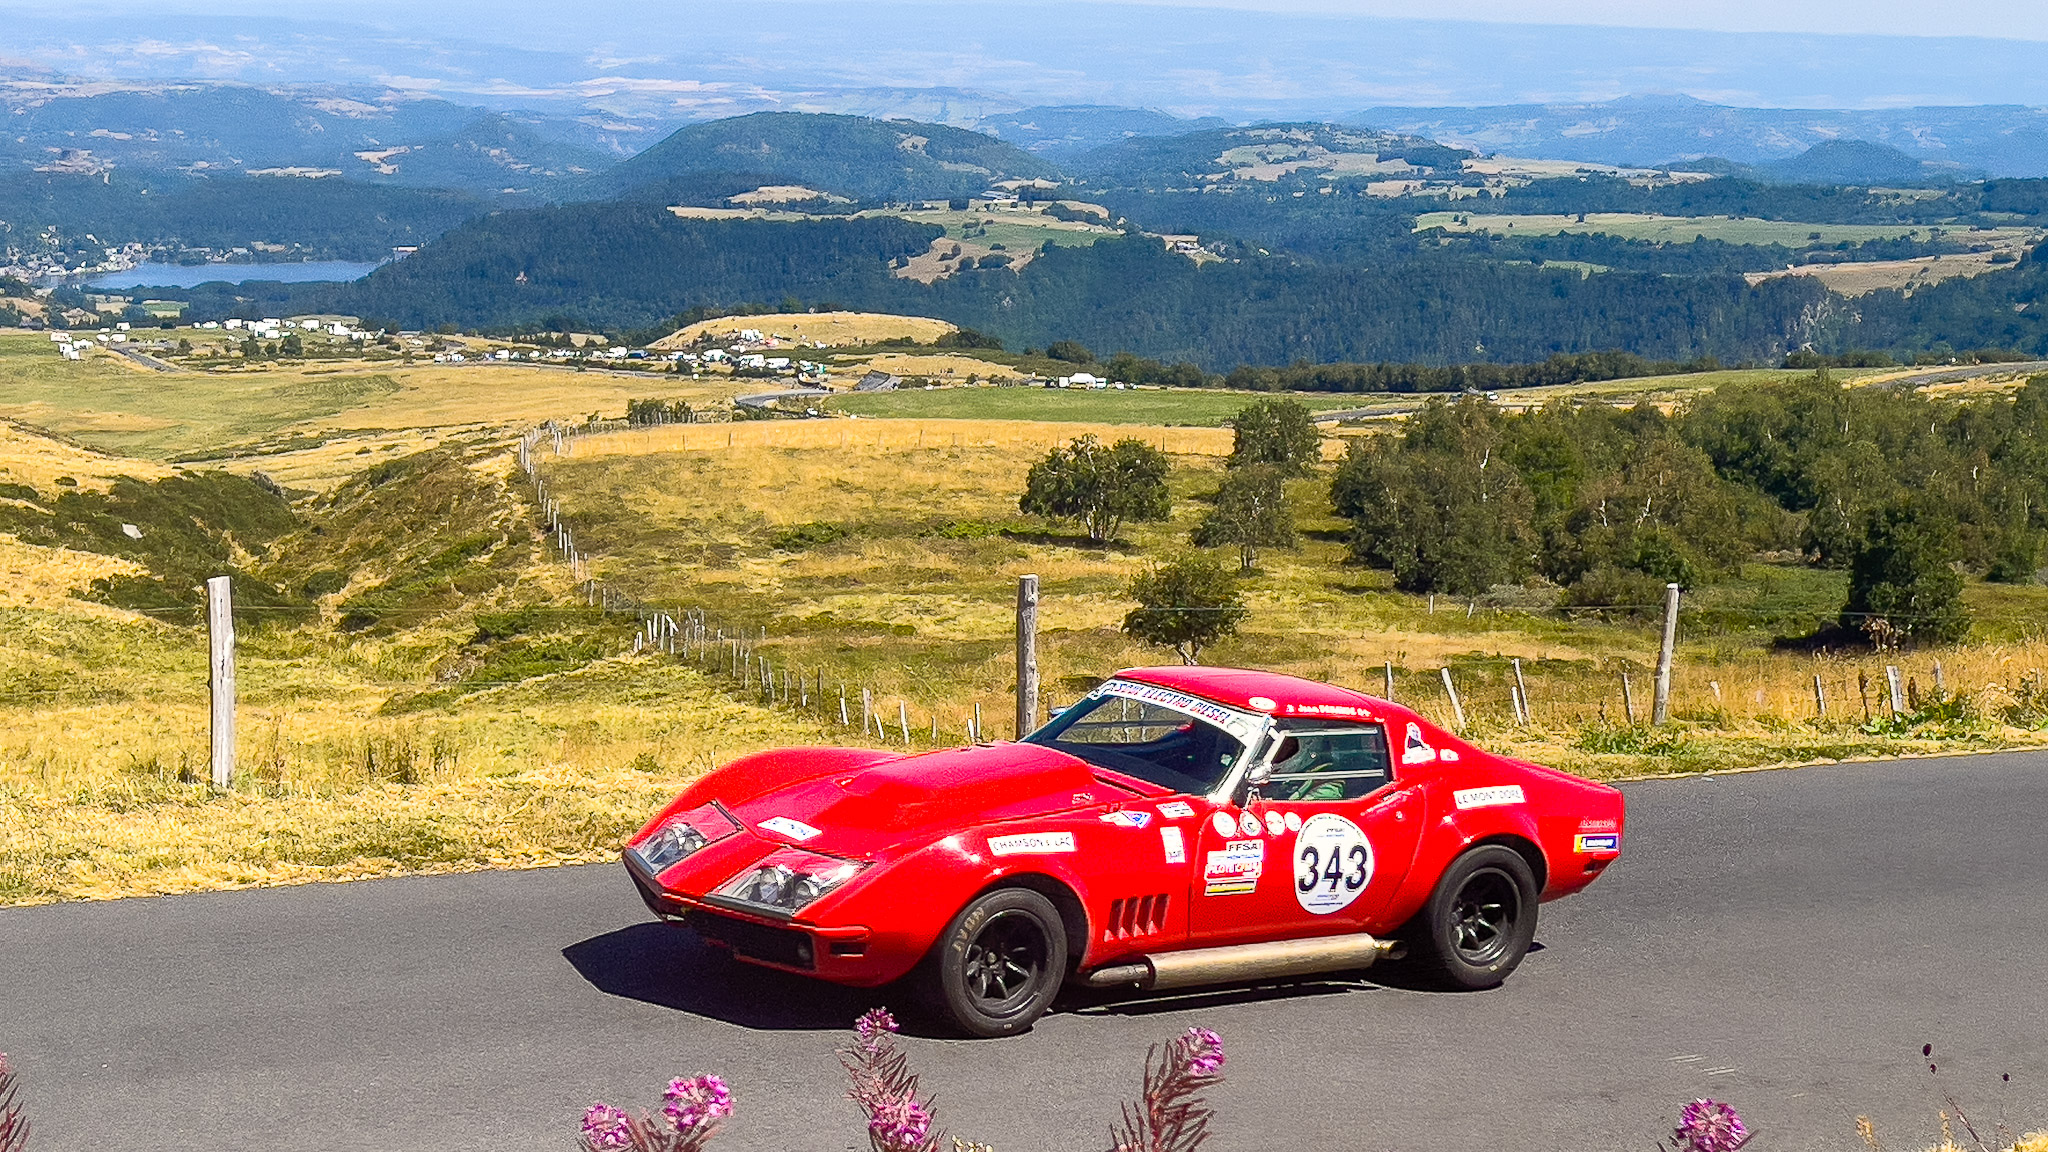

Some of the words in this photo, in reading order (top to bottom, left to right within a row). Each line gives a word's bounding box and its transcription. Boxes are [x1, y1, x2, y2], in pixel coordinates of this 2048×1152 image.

[1142, 688, 1194, 709] ELECTRO
[1190, 702, 1232, 725] DIESEL
[1458, 793, 1469, 805] LE
[1228, 842, 1259, 852] FFSA
[1298, 844, 1367, 894] 343
[951, 906, 985, 953] AVON
